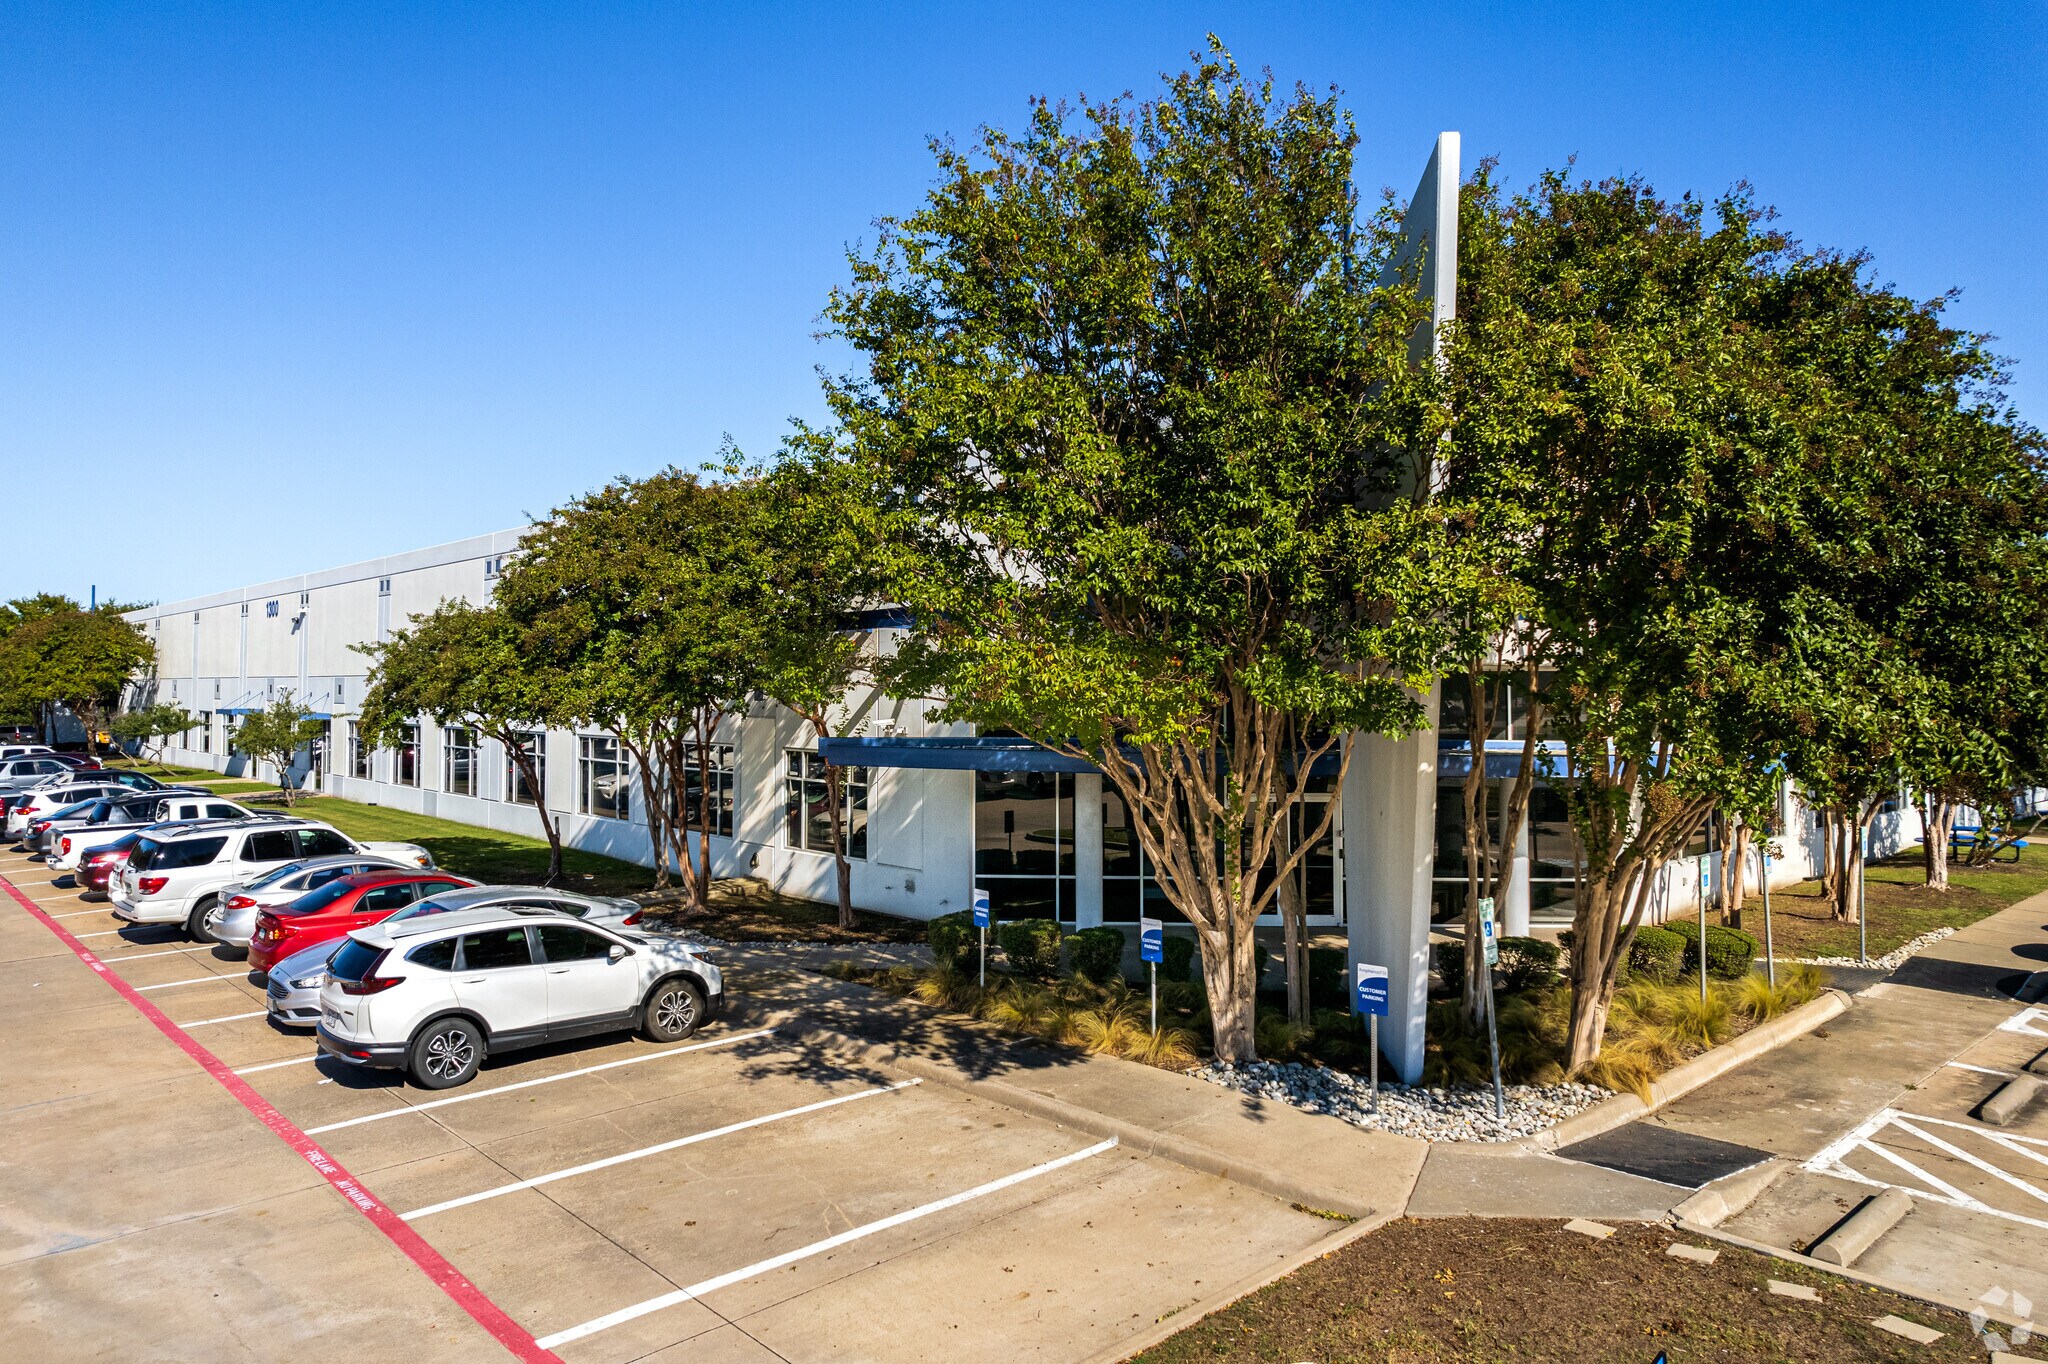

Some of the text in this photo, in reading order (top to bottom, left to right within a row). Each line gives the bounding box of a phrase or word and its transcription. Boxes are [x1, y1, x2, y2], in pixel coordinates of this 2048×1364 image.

[266, 600, 279, 618] 1300
[1142, 937, 1161, 945] CUSTOMER
[1359, 986, 1386, 995] CUSTOMER
[1361, 993, 1384, 1002] PARKING
[304, 1149, 376, 1210] FIRE LANE NO PARKING
